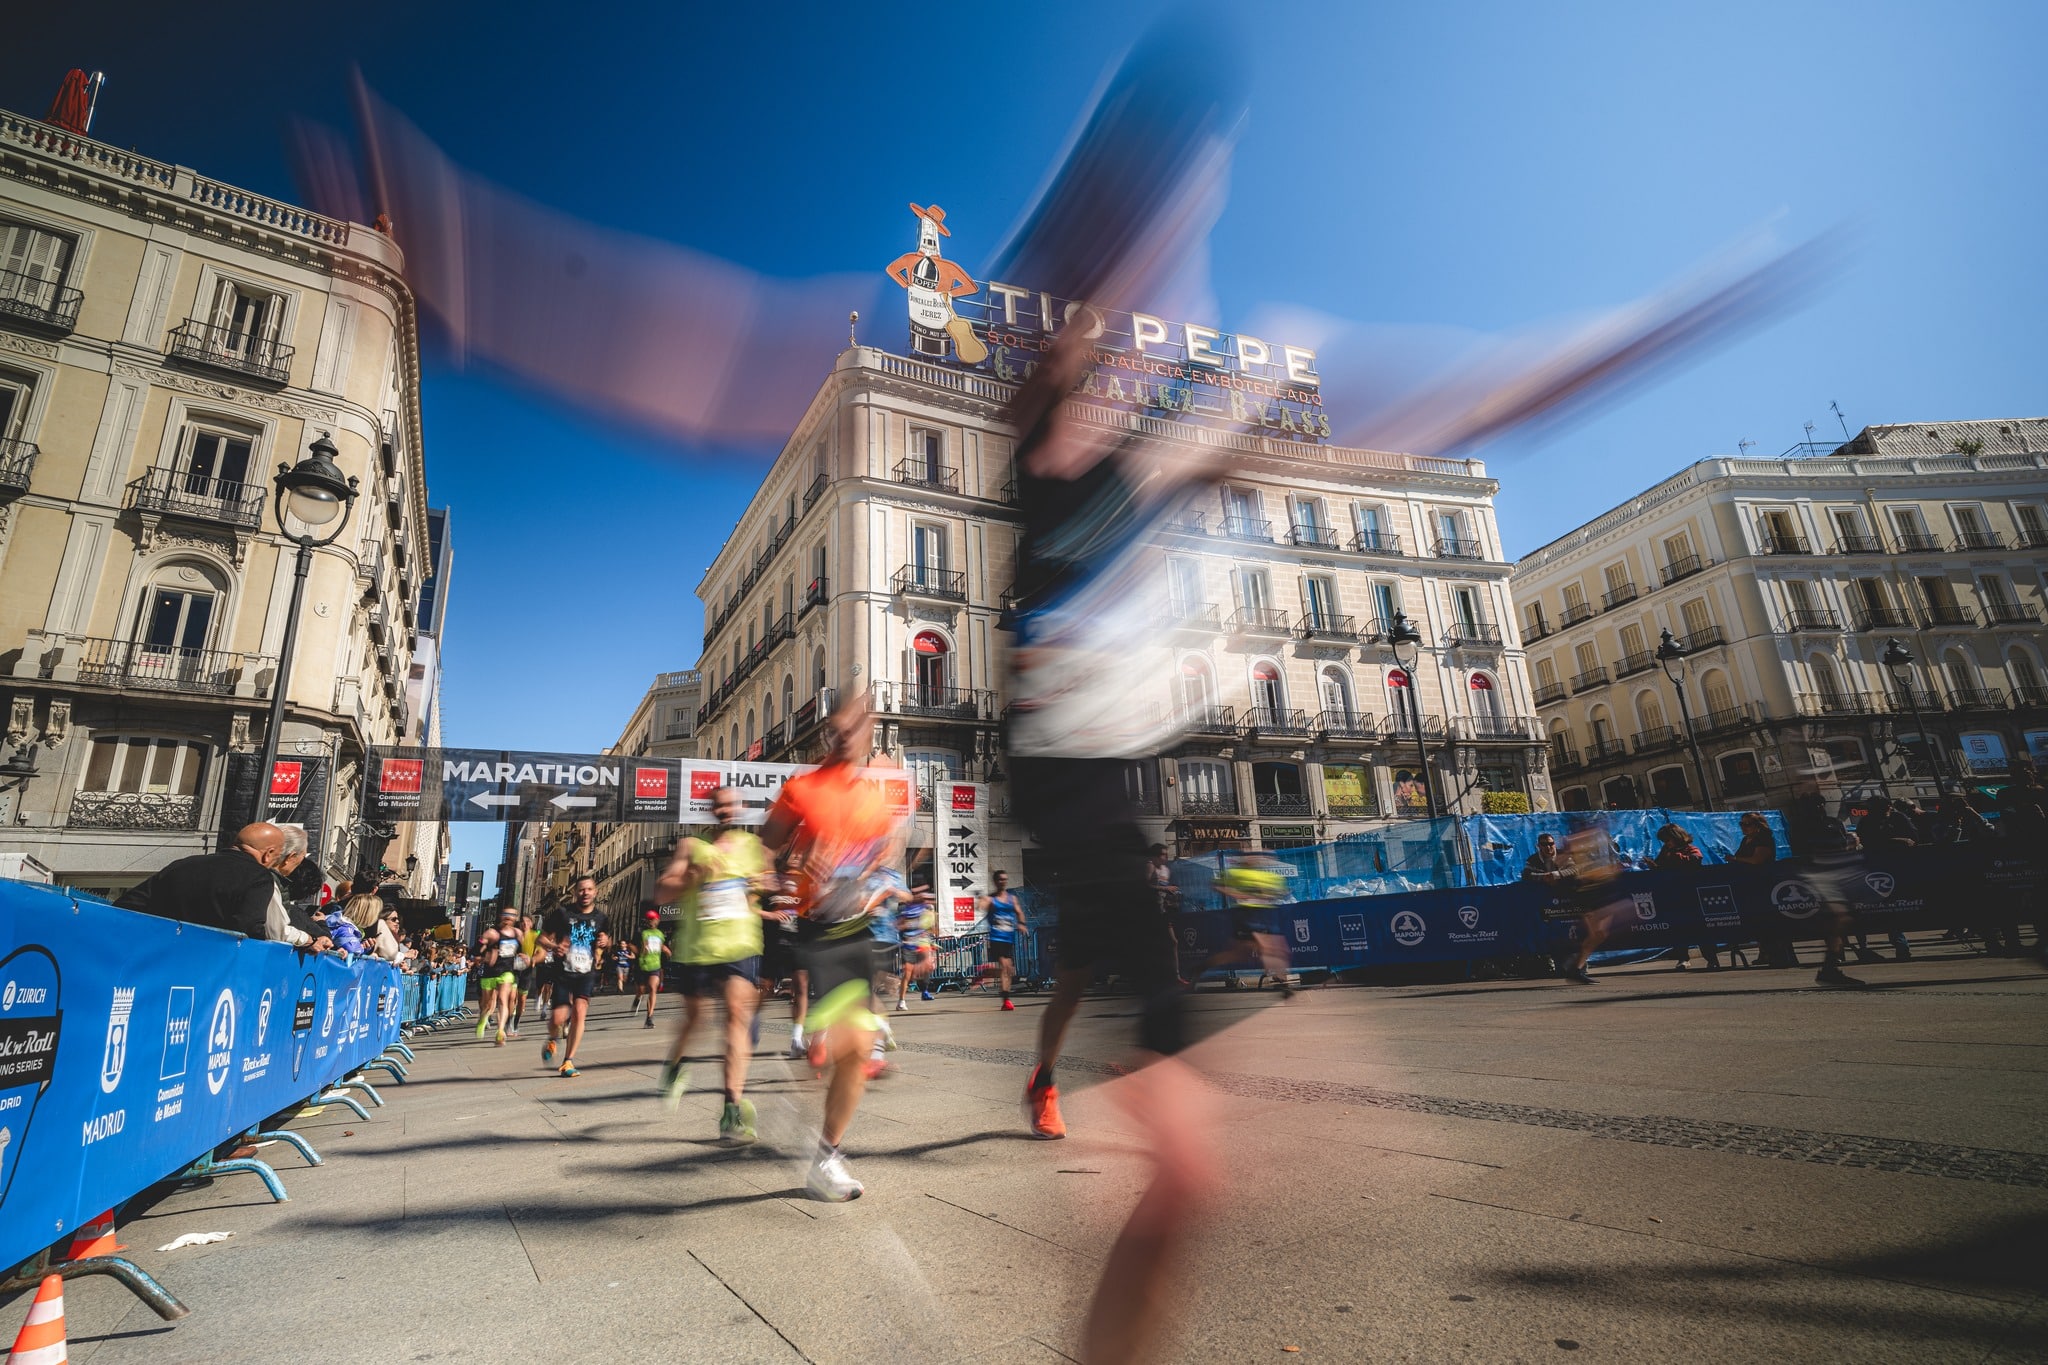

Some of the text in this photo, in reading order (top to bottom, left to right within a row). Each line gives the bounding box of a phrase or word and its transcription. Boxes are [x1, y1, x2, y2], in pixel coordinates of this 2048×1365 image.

[920, 309, 942, 319] JEREZ
[914, 325, 927, 334] FINO
[990, 281, 1321, 386] TIO PEPE
[988, 331, 1030, 349] SOL
[1040, 338, 1050, 352] D
[1192, 370, 1322, 405] EMBOTELLADO
[994, 346, 1331, 438] GOZALEZ BYASS
[443, 761, 619, 786] MARATHON
[727, 773, 776, 788] HALF
[1194, 828, 1239, 839] PALAZZO
[947, 842, 978, 858] 21K
[951, 862, 974, 873] 10K
[1778, 900, 1821, 911] MAPOMA
[1705, 914, 1740, 922] Comunidad
[1394, 930, 1426, 938] MAPOMA
[1631, 922, 1669, 932] MADRID
[1291, 945, 1318, 953] MADRID
[16, 988, 47, 1004] ZURICH
[16, 1058, 43, 1074] SERIES
[208, 1051, 230, 1071] MAPOMA
[157, 1083, 184, 1103] Comunidad
[0, 1095, 22, 1111] DRID
[155, 1099, 182, 1122] de Madrid
[82, 1109, 125, 1147] MADRID
